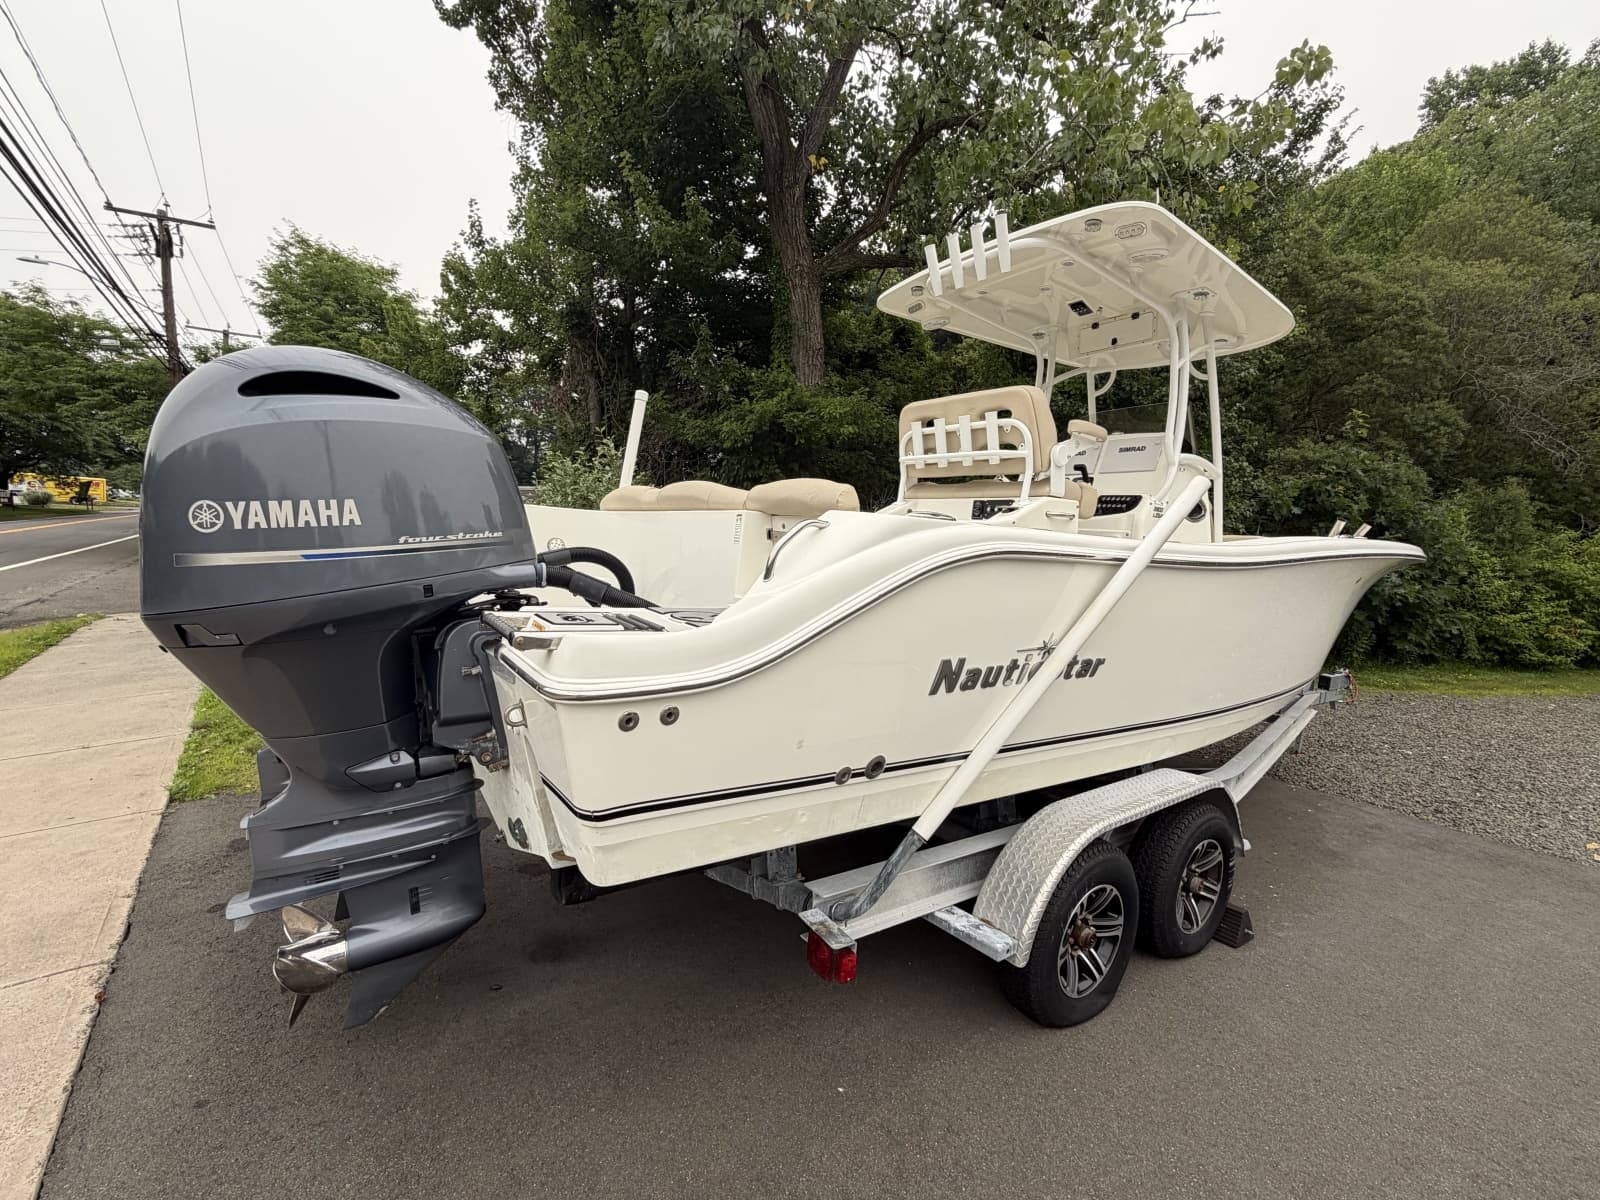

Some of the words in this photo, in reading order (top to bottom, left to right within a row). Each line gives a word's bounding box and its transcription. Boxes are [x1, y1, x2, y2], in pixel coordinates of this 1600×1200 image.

[1118, 445, 1147, 453] SIMRAD
[225, 498, 362, 529] YAMAHA
[928, 654, 1106, 695] Nautitar
